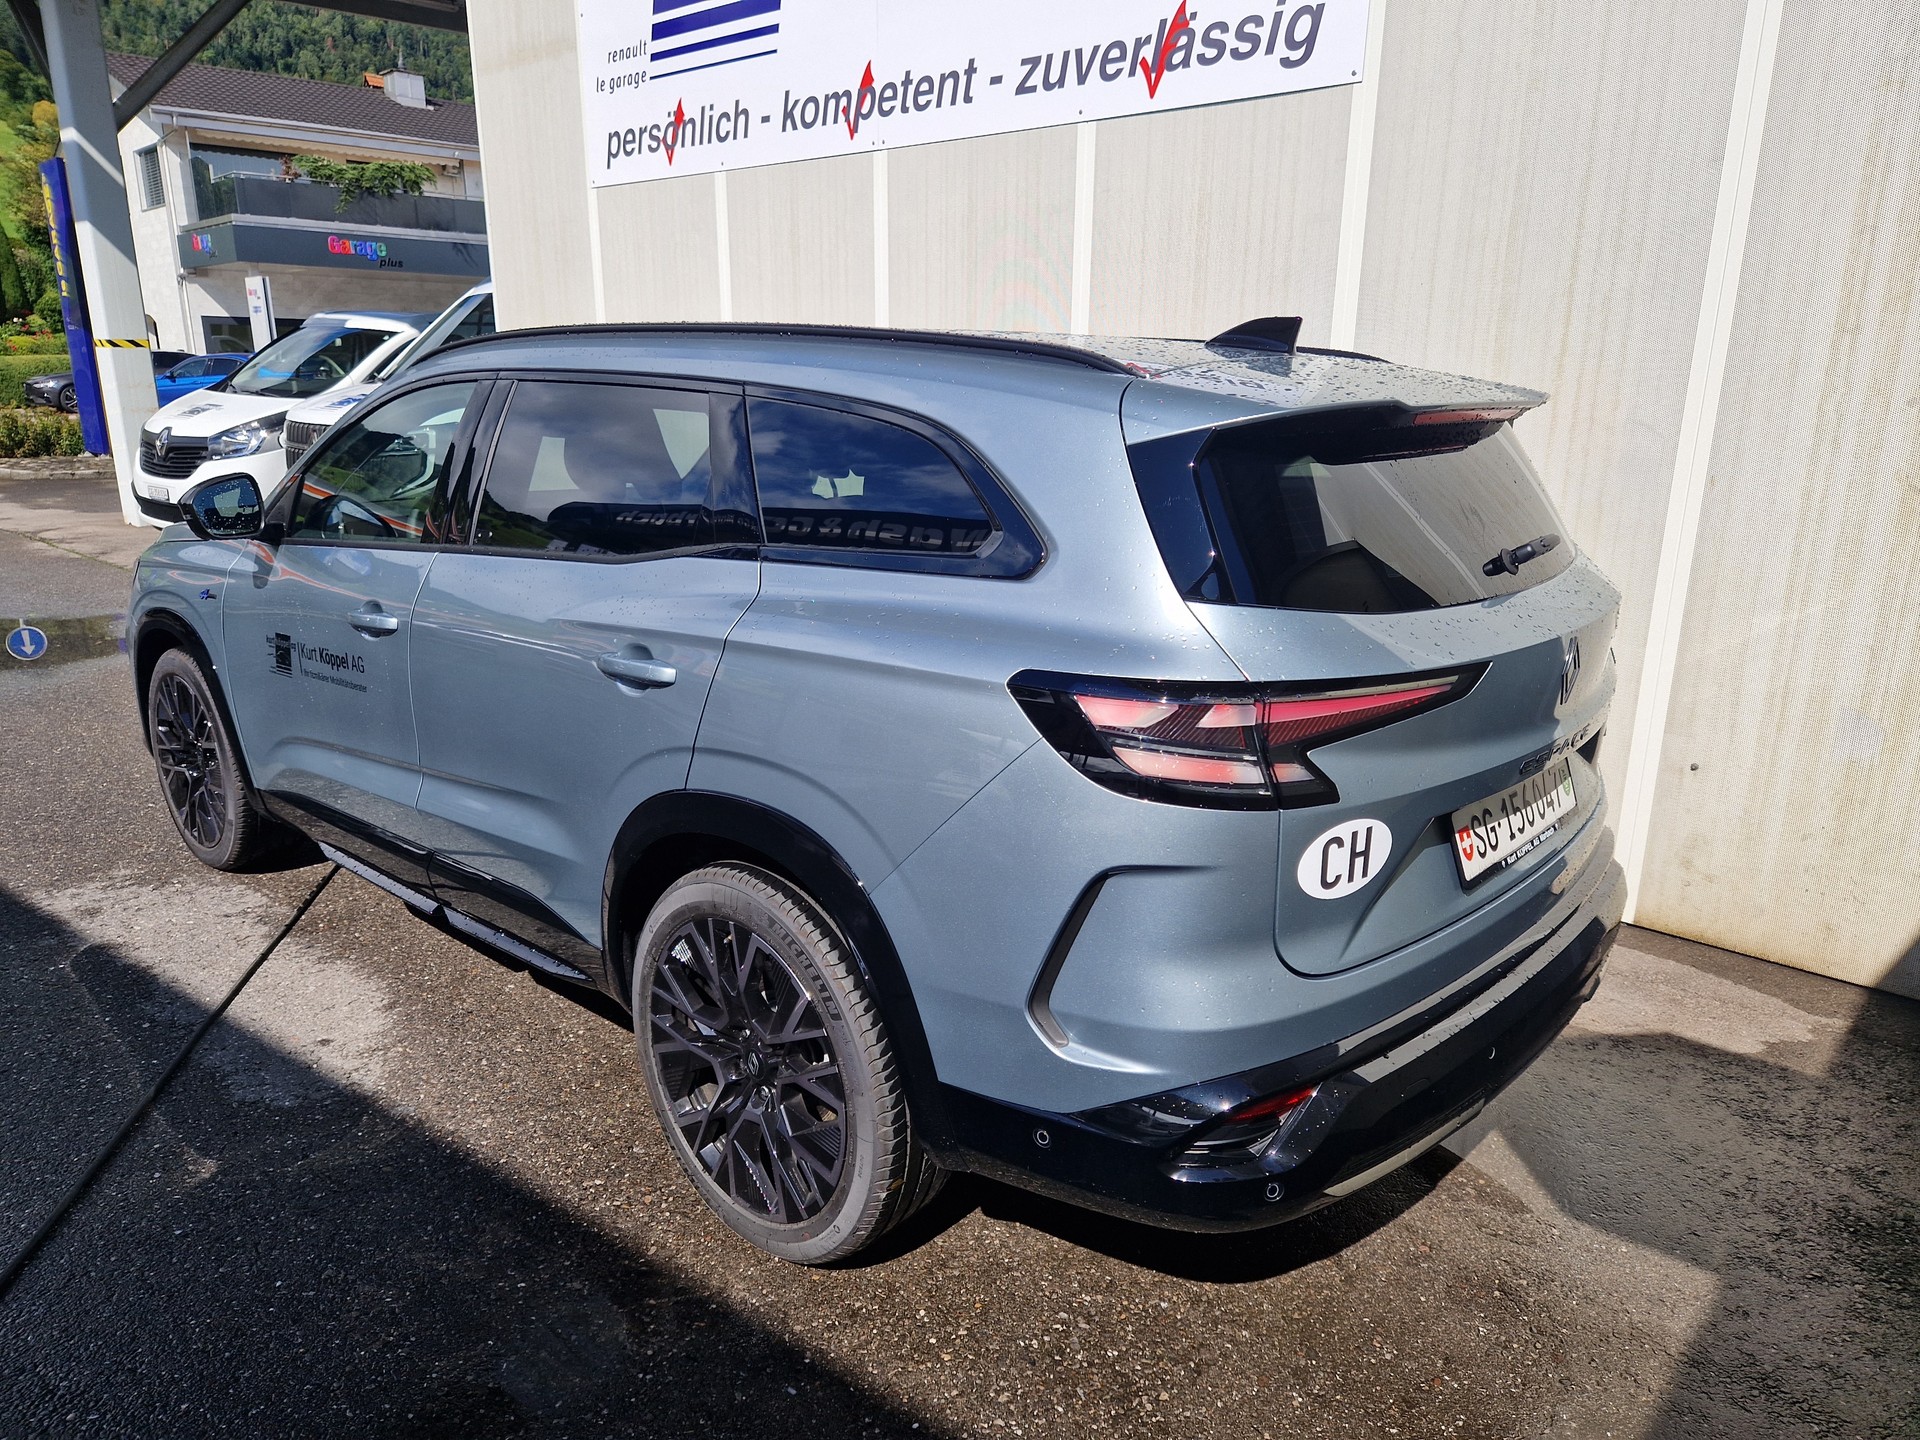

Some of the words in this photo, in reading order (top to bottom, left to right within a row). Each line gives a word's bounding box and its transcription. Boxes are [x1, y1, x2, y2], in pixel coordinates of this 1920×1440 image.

[608, 39, 647, 64] renault
[596, 76, 606, 93] le
[609, 70, 647, 94] garage
[607, 99, 750, 170] persönlich
[781, 58, 978, 134] kompetent
[1015, 0, 1326, 96] zuverlässig
[328, 235, 387, 261] Garage
[379, 258, 404, 268] plus
[300, 643, 318, 662] Kurt
[319, 647, 350, 671] Köppel
[352, 655, 365, 673] AG
[1320, 826, 1373, 890] CH
[771, 921, 840, 1015] MICHELIN
